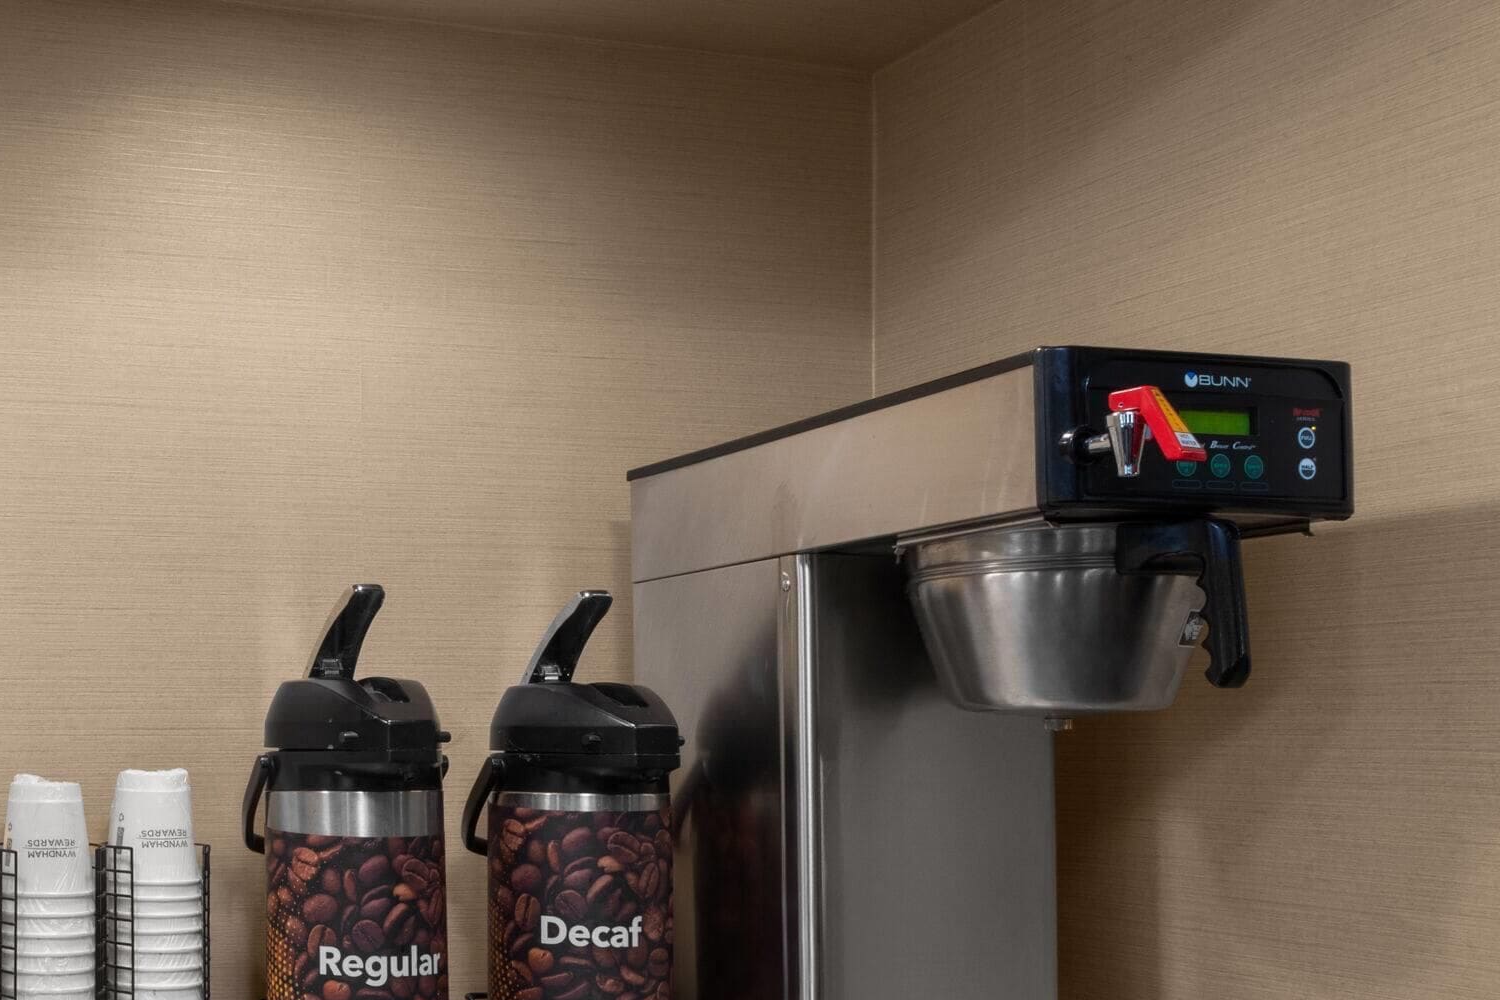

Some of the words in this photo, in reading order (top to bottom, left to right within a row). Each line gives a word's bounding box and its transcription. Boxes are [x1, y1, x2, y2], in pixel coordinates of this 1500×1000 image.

[1199, 374, 1249, 388] BUNN
[141, 829, 188, 837] REWARDS
[27, 838, 76, 847] REWARDS
[141, 840, 188, 849] WYNDHAM
[27, 850, 77, 859] WYNDHAM
[540, 915, 642, 948] Decaf
[318, 945, 441, 987] Regular
